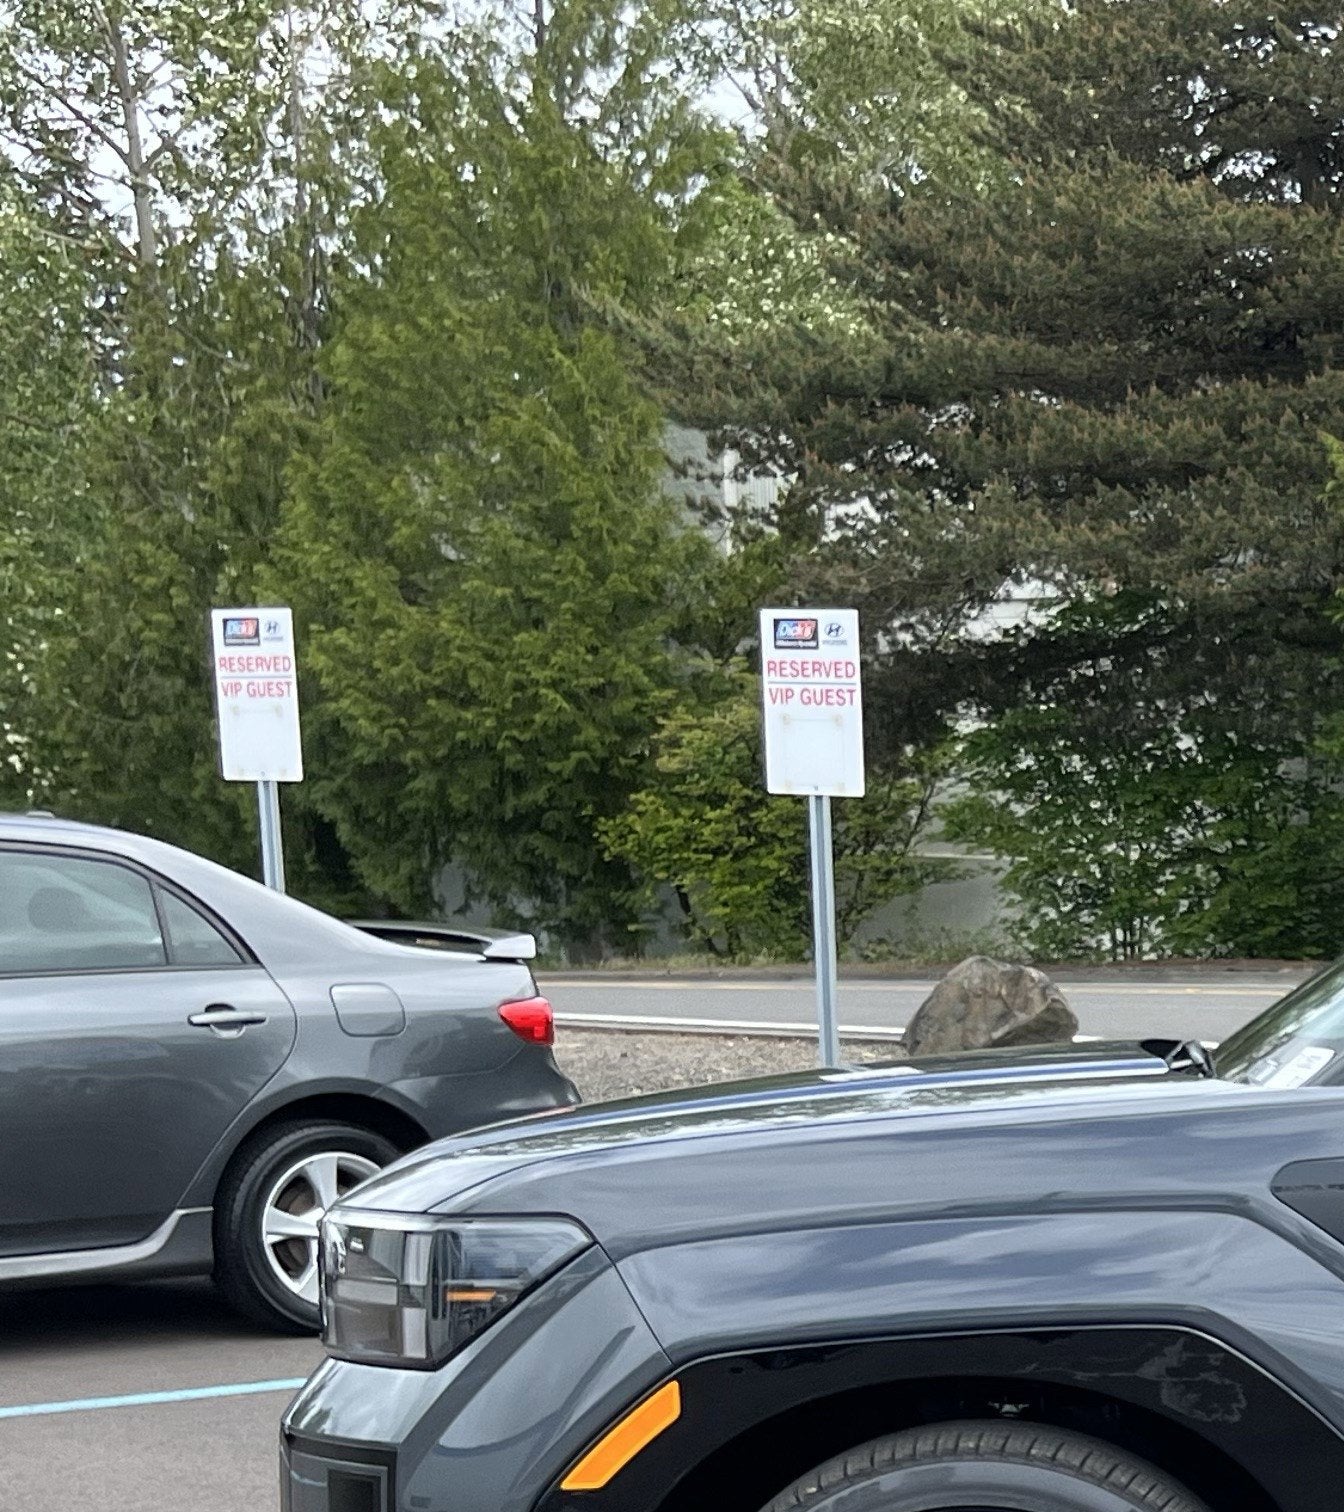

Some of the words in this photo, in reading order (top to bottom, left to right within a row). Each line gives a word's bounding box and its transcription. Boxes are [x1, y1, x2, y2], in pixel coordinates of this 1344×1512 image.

[219, 656, 291, 673] RESERVED
[767, 660, 856, 678] RESERVED
[221, 682, 242, 698] VIP
[246, 681, 292, 698] GUEST
[769, 688, 794, 705] VIP
[800, 688, 857, 706] GUEST
